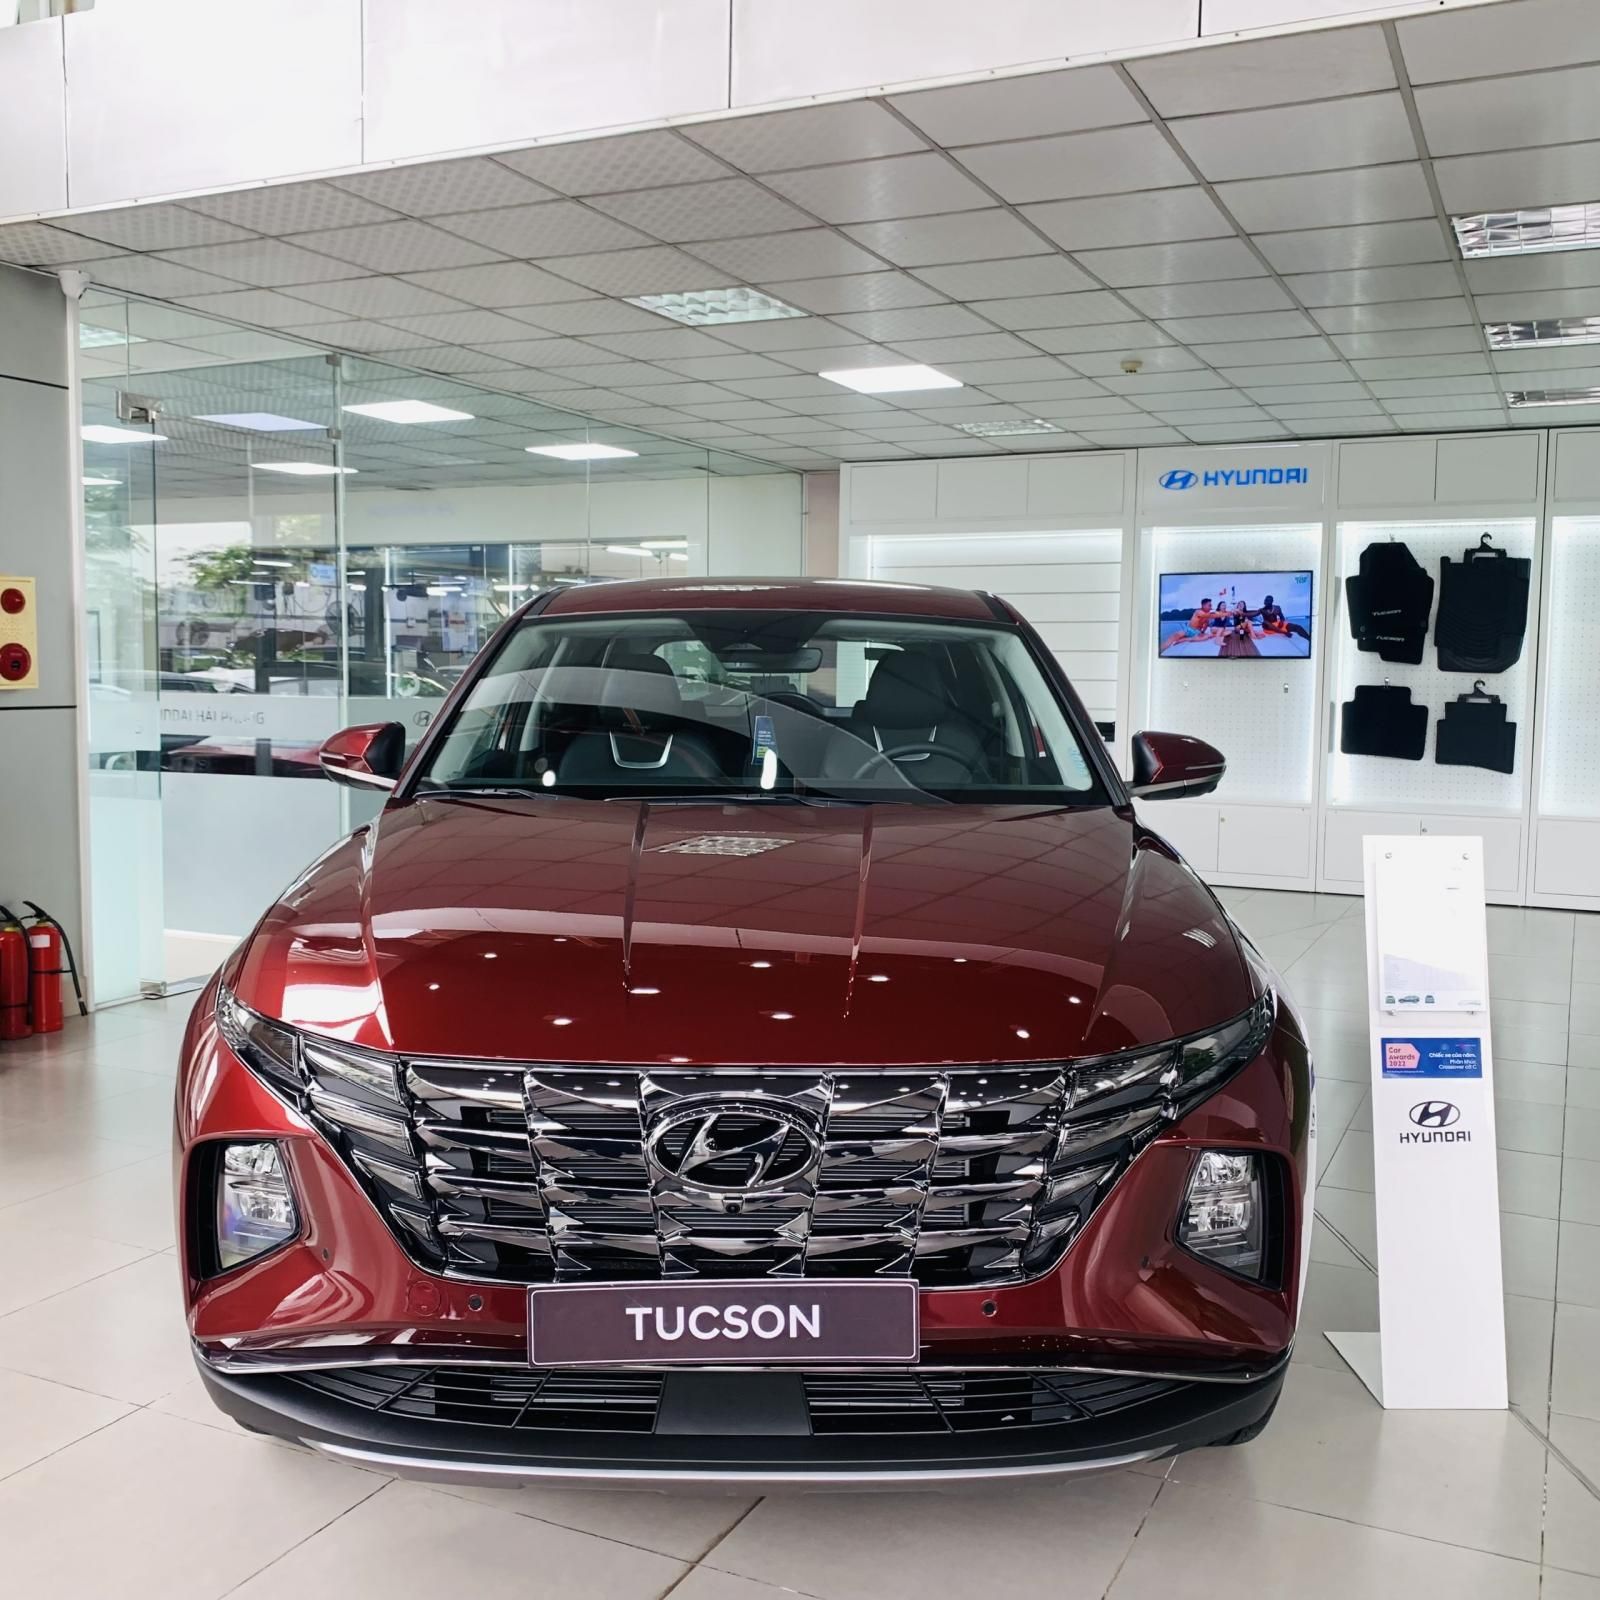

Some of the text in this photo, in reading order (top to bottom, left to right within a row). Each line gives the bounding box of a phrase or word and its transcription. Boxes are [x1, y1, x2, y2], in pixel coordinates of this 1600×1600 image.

[1203, 467, 1308, 486] HYUNDAI
[1388, 1046, 1401, 1054] Car
[1388, 1053, 1416, 1061] Awards
[1399, 1131, 1471, 1144] HYUNDAI
[625, 1304, 820, 1341] TUCSON
